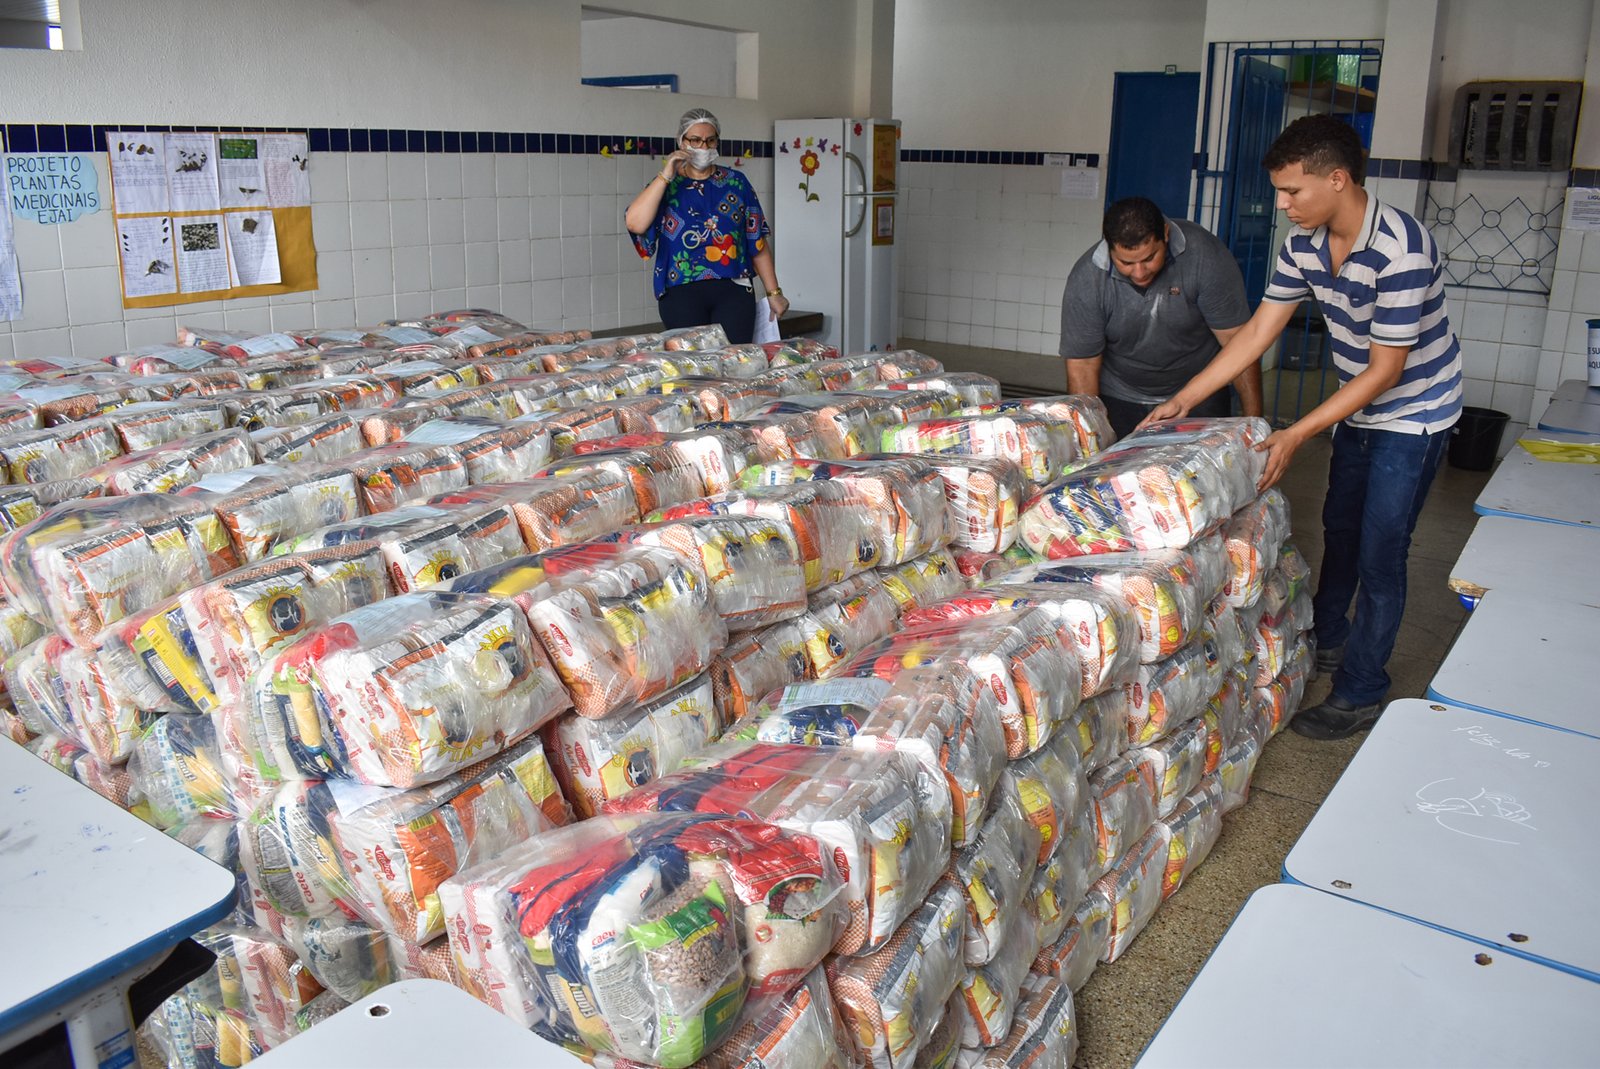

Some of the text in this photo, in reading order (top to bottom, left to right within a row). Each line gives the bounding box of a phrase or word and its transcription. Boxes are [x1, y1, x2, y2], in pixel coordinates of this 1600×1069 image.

[7, 156, 81, 173] PROJETO
[10, 175, 81, 191] PLANTAS
[13, 192, 97, 210] MEDICINAIS
[38, 209, 72, 224] EJAI
